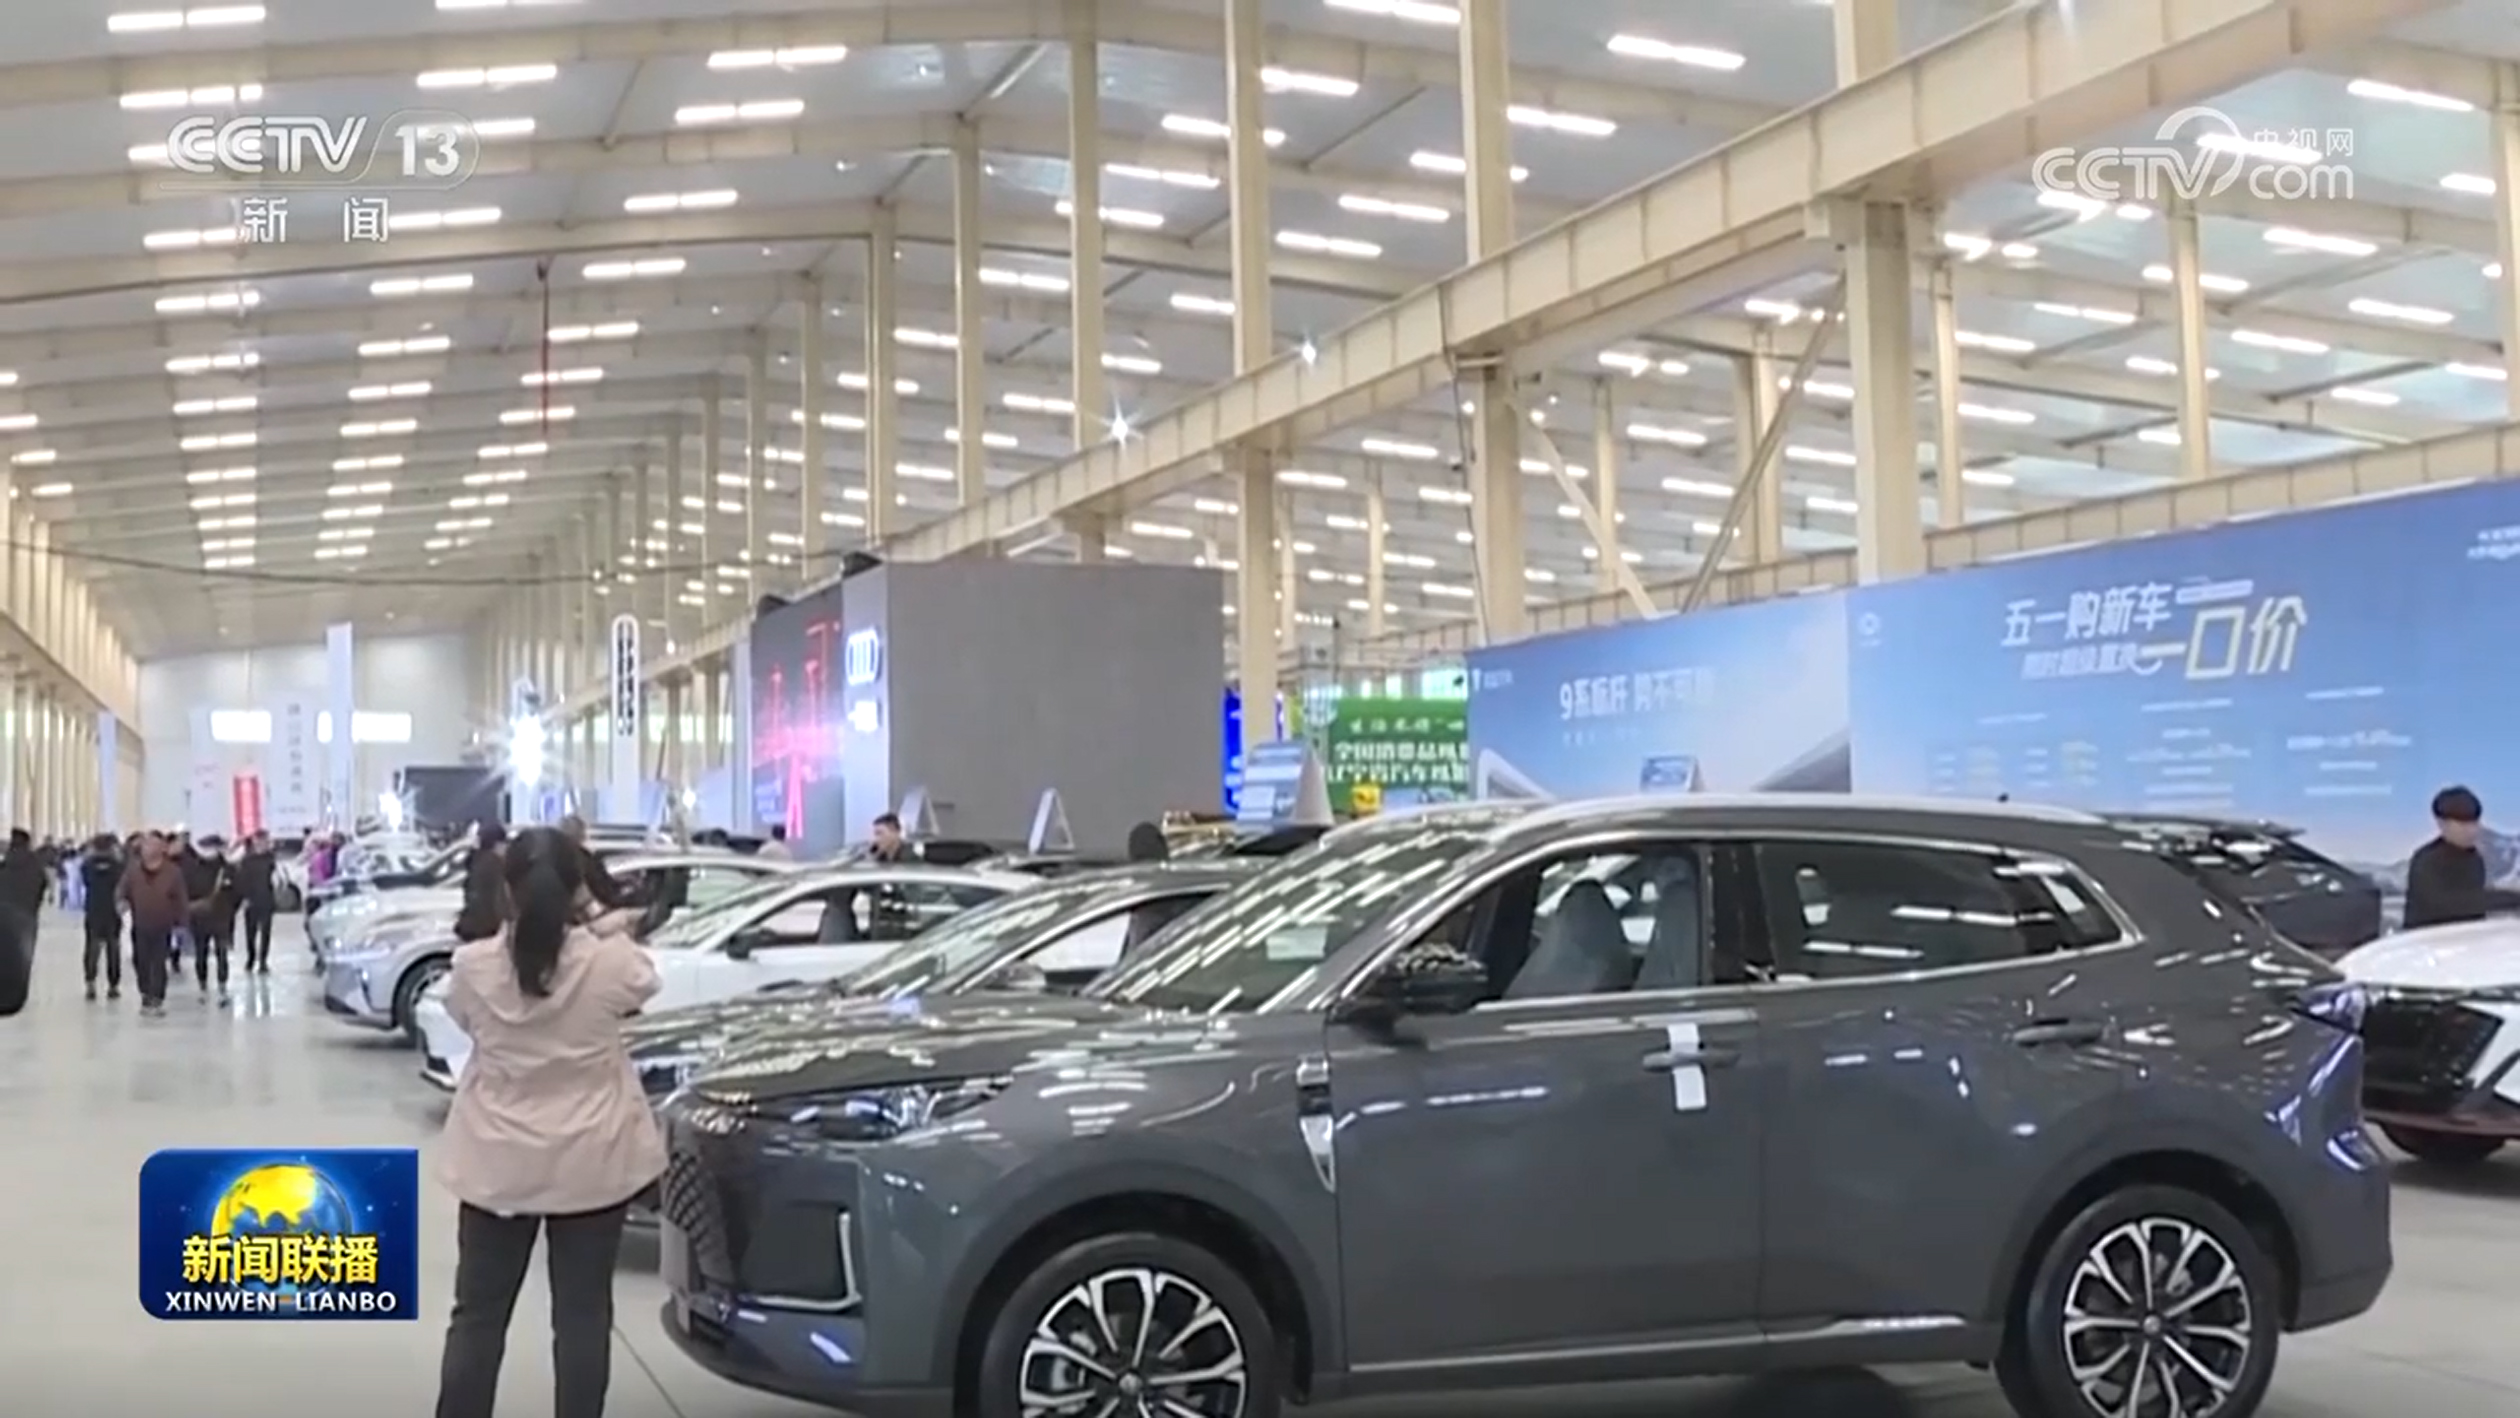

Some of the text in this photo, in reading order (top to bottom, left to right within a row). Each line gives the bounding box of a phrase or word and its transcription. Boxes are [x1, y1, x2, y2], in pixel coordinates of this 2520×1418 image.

[2001, 582, 2173, 646] 五一购新车
